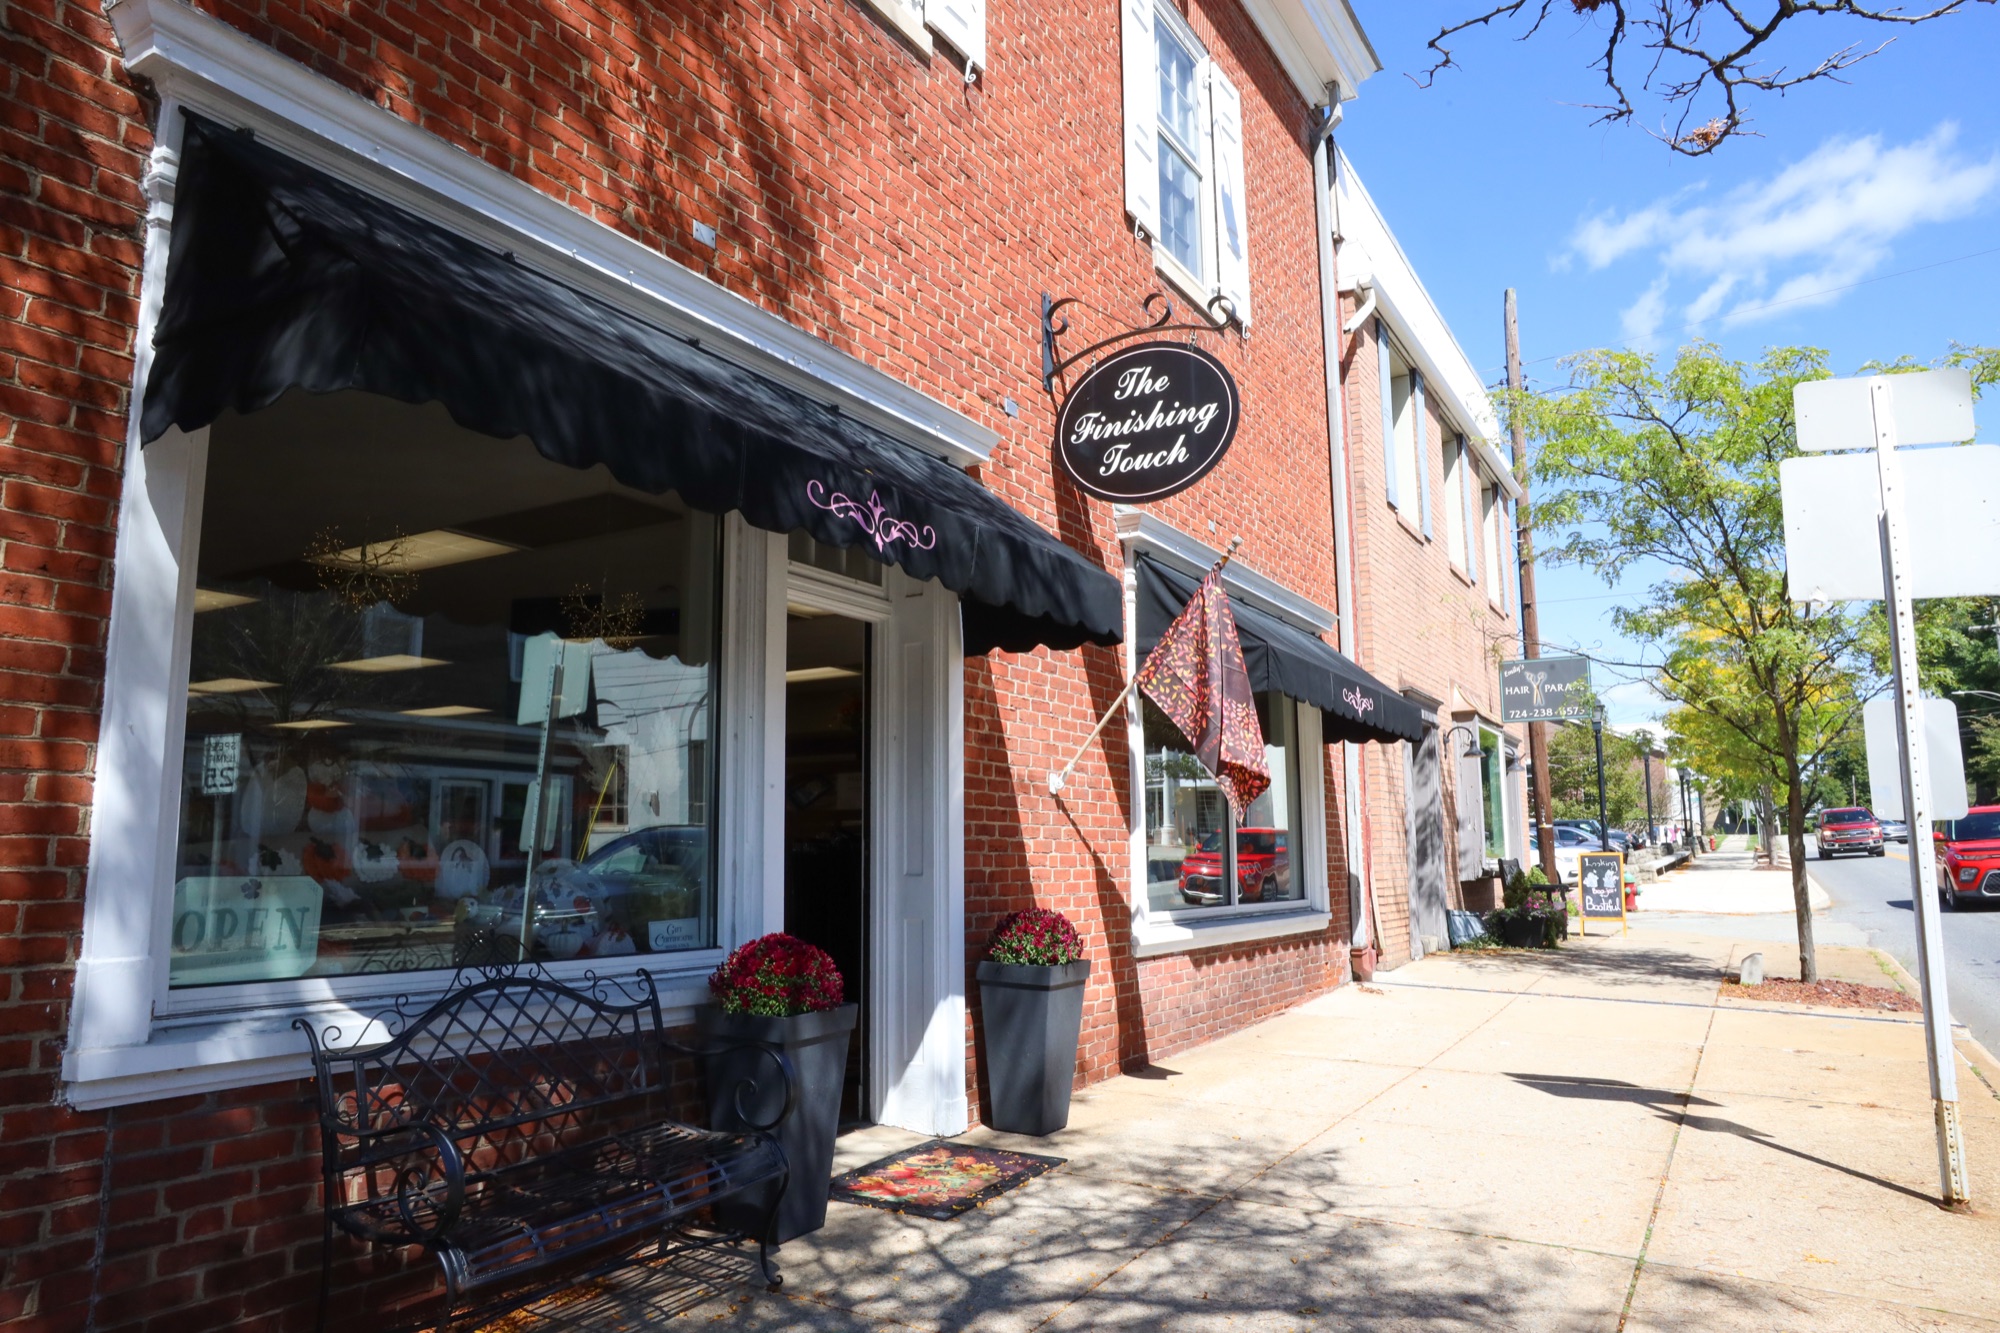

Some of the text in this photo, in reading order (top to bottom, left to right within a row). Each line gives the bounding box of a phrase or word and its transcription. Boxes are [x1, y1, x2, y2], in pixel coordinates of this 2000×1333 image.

[1114, 366, 1170, 400] The
[1070, 400, 1219, 444] Finishing
[1099, 434, 1189, 476] Touch
[1504, 664, 1524, 678] Emily's
[1505, 681, 1584, 695] HAIR PARA
[1584, 857, 1618, 873] Looking
[172, 906, 310, 952] OPEN
